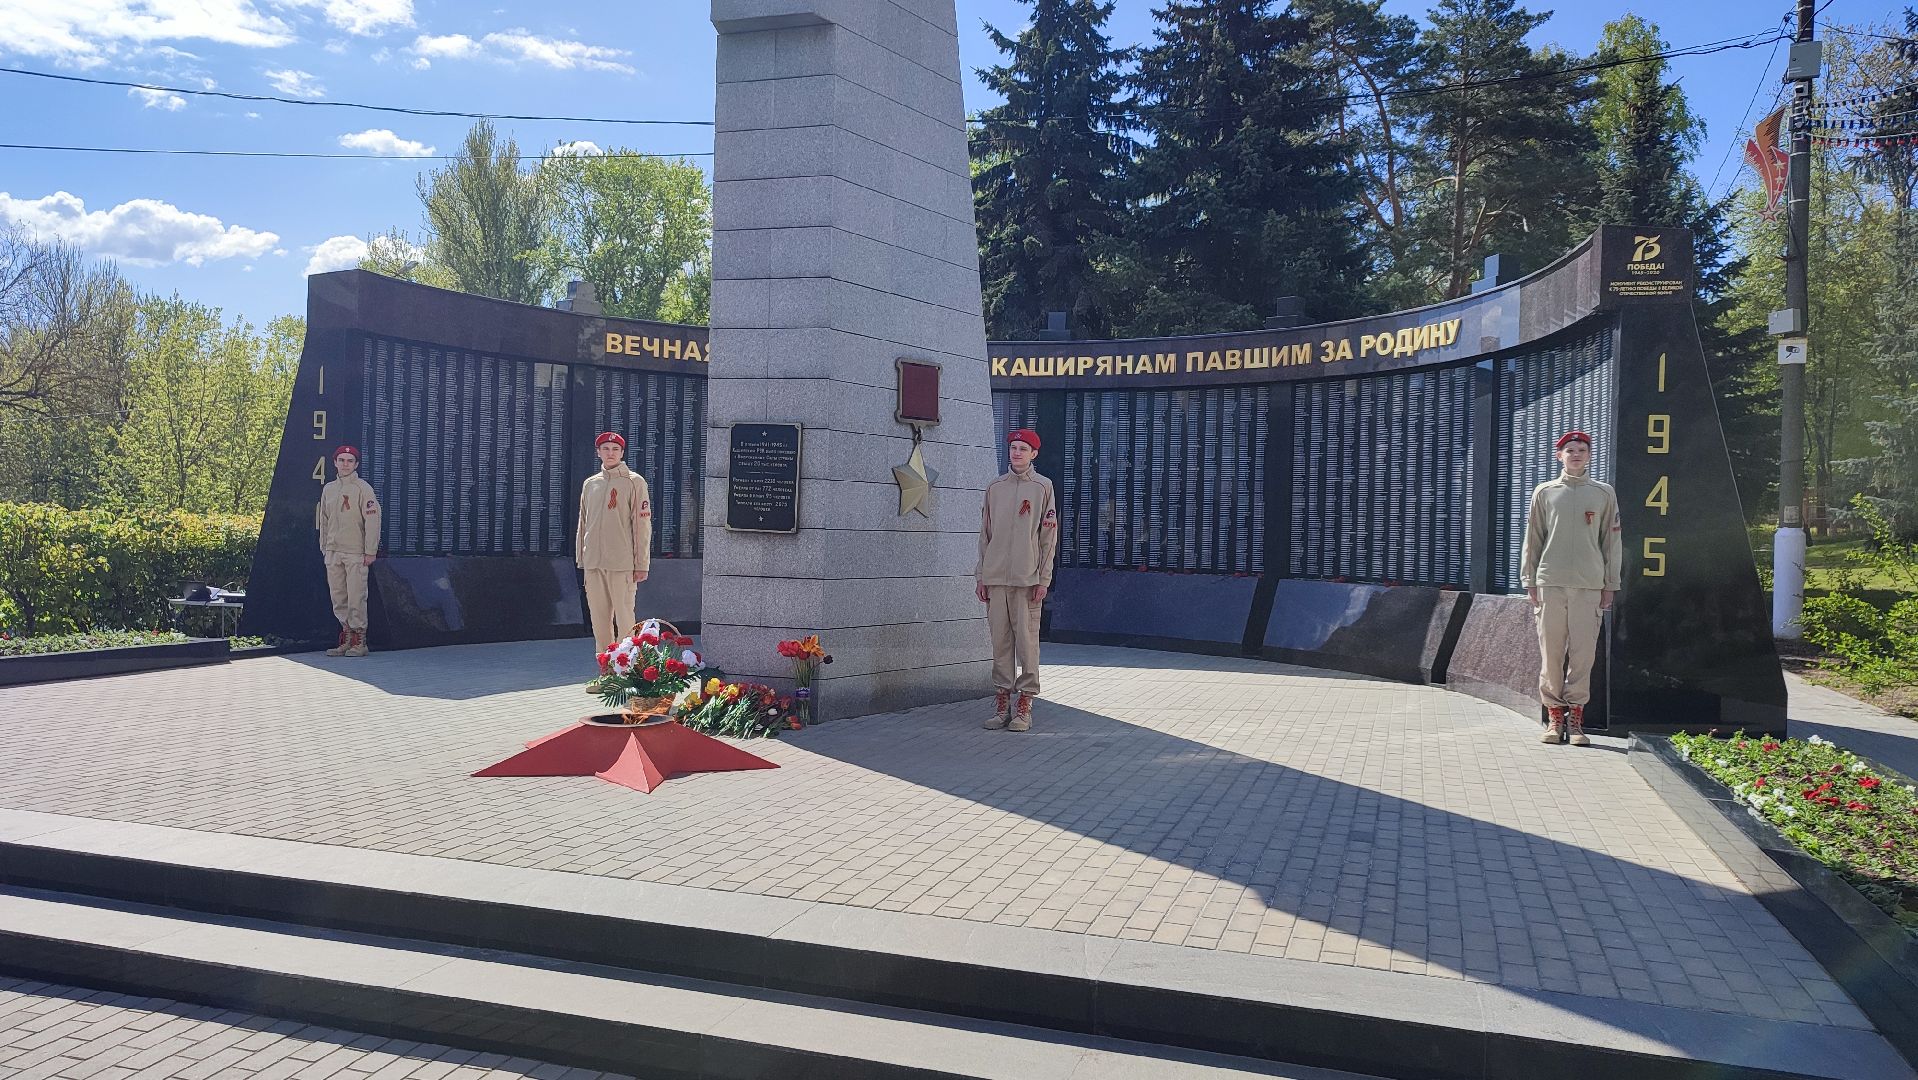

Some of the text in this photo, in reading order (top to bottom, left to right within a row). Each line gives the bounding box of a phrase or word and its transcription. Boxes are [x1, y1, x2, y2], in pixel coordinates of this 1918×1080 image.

[1632, 234, 1660, 261] 75
[991, 318, 1461, 377] КАШИРЯНАМ ПАВШИМ ЗА РОДИНУ
